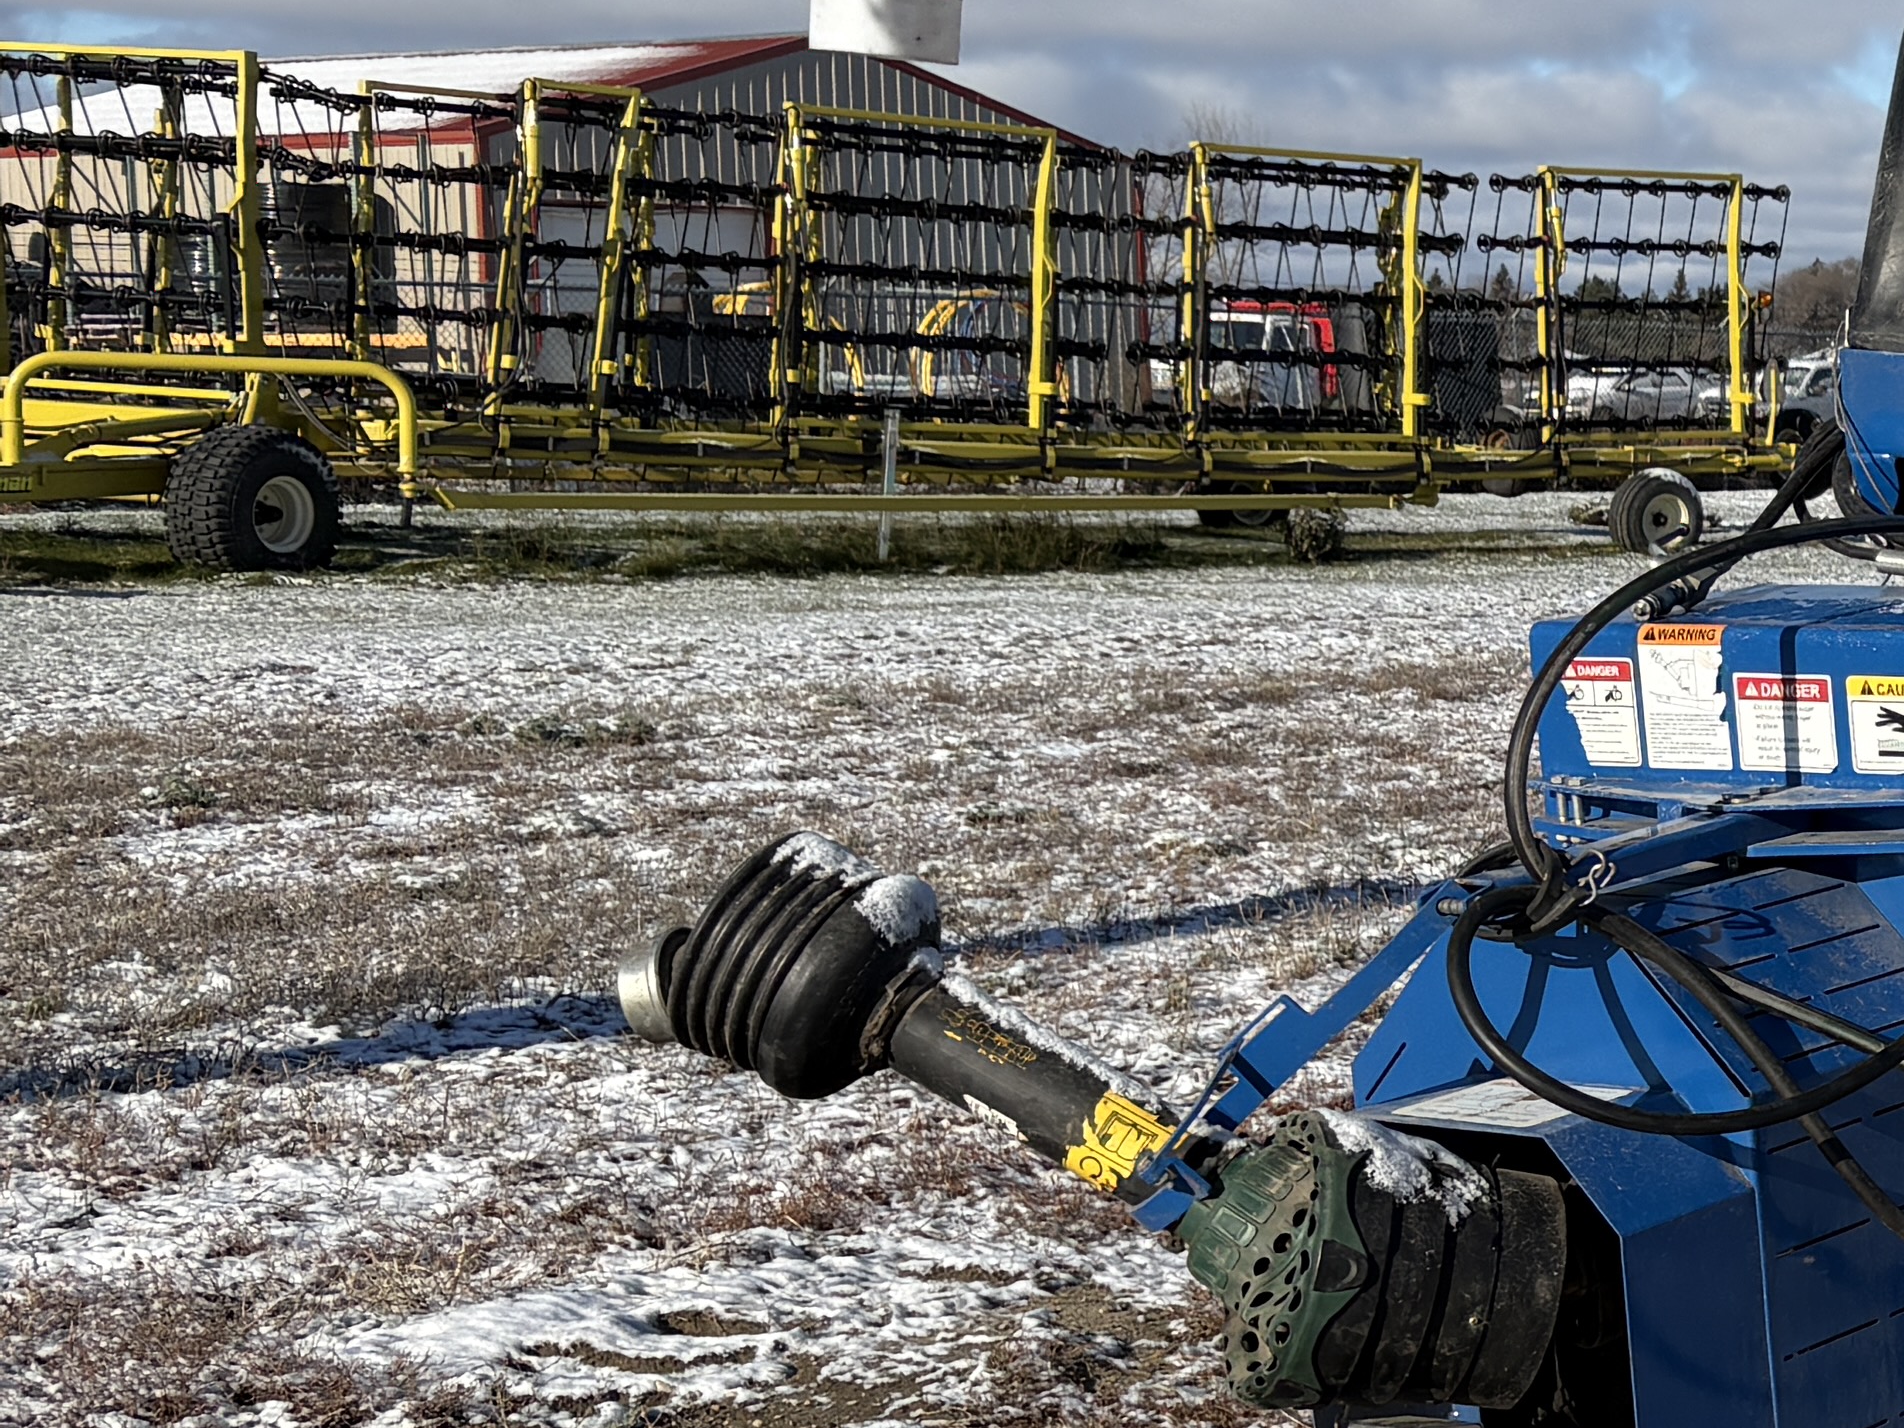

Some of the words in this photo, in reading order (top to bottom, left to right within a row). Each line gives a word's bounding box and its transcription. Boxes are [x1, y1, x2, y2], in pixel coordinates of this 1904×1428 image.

[1657, 628, 1717, 642] WARNING
[1576, 664, 1620, 677] DANGER
[1760, 682, 1821, 699] DANGER
